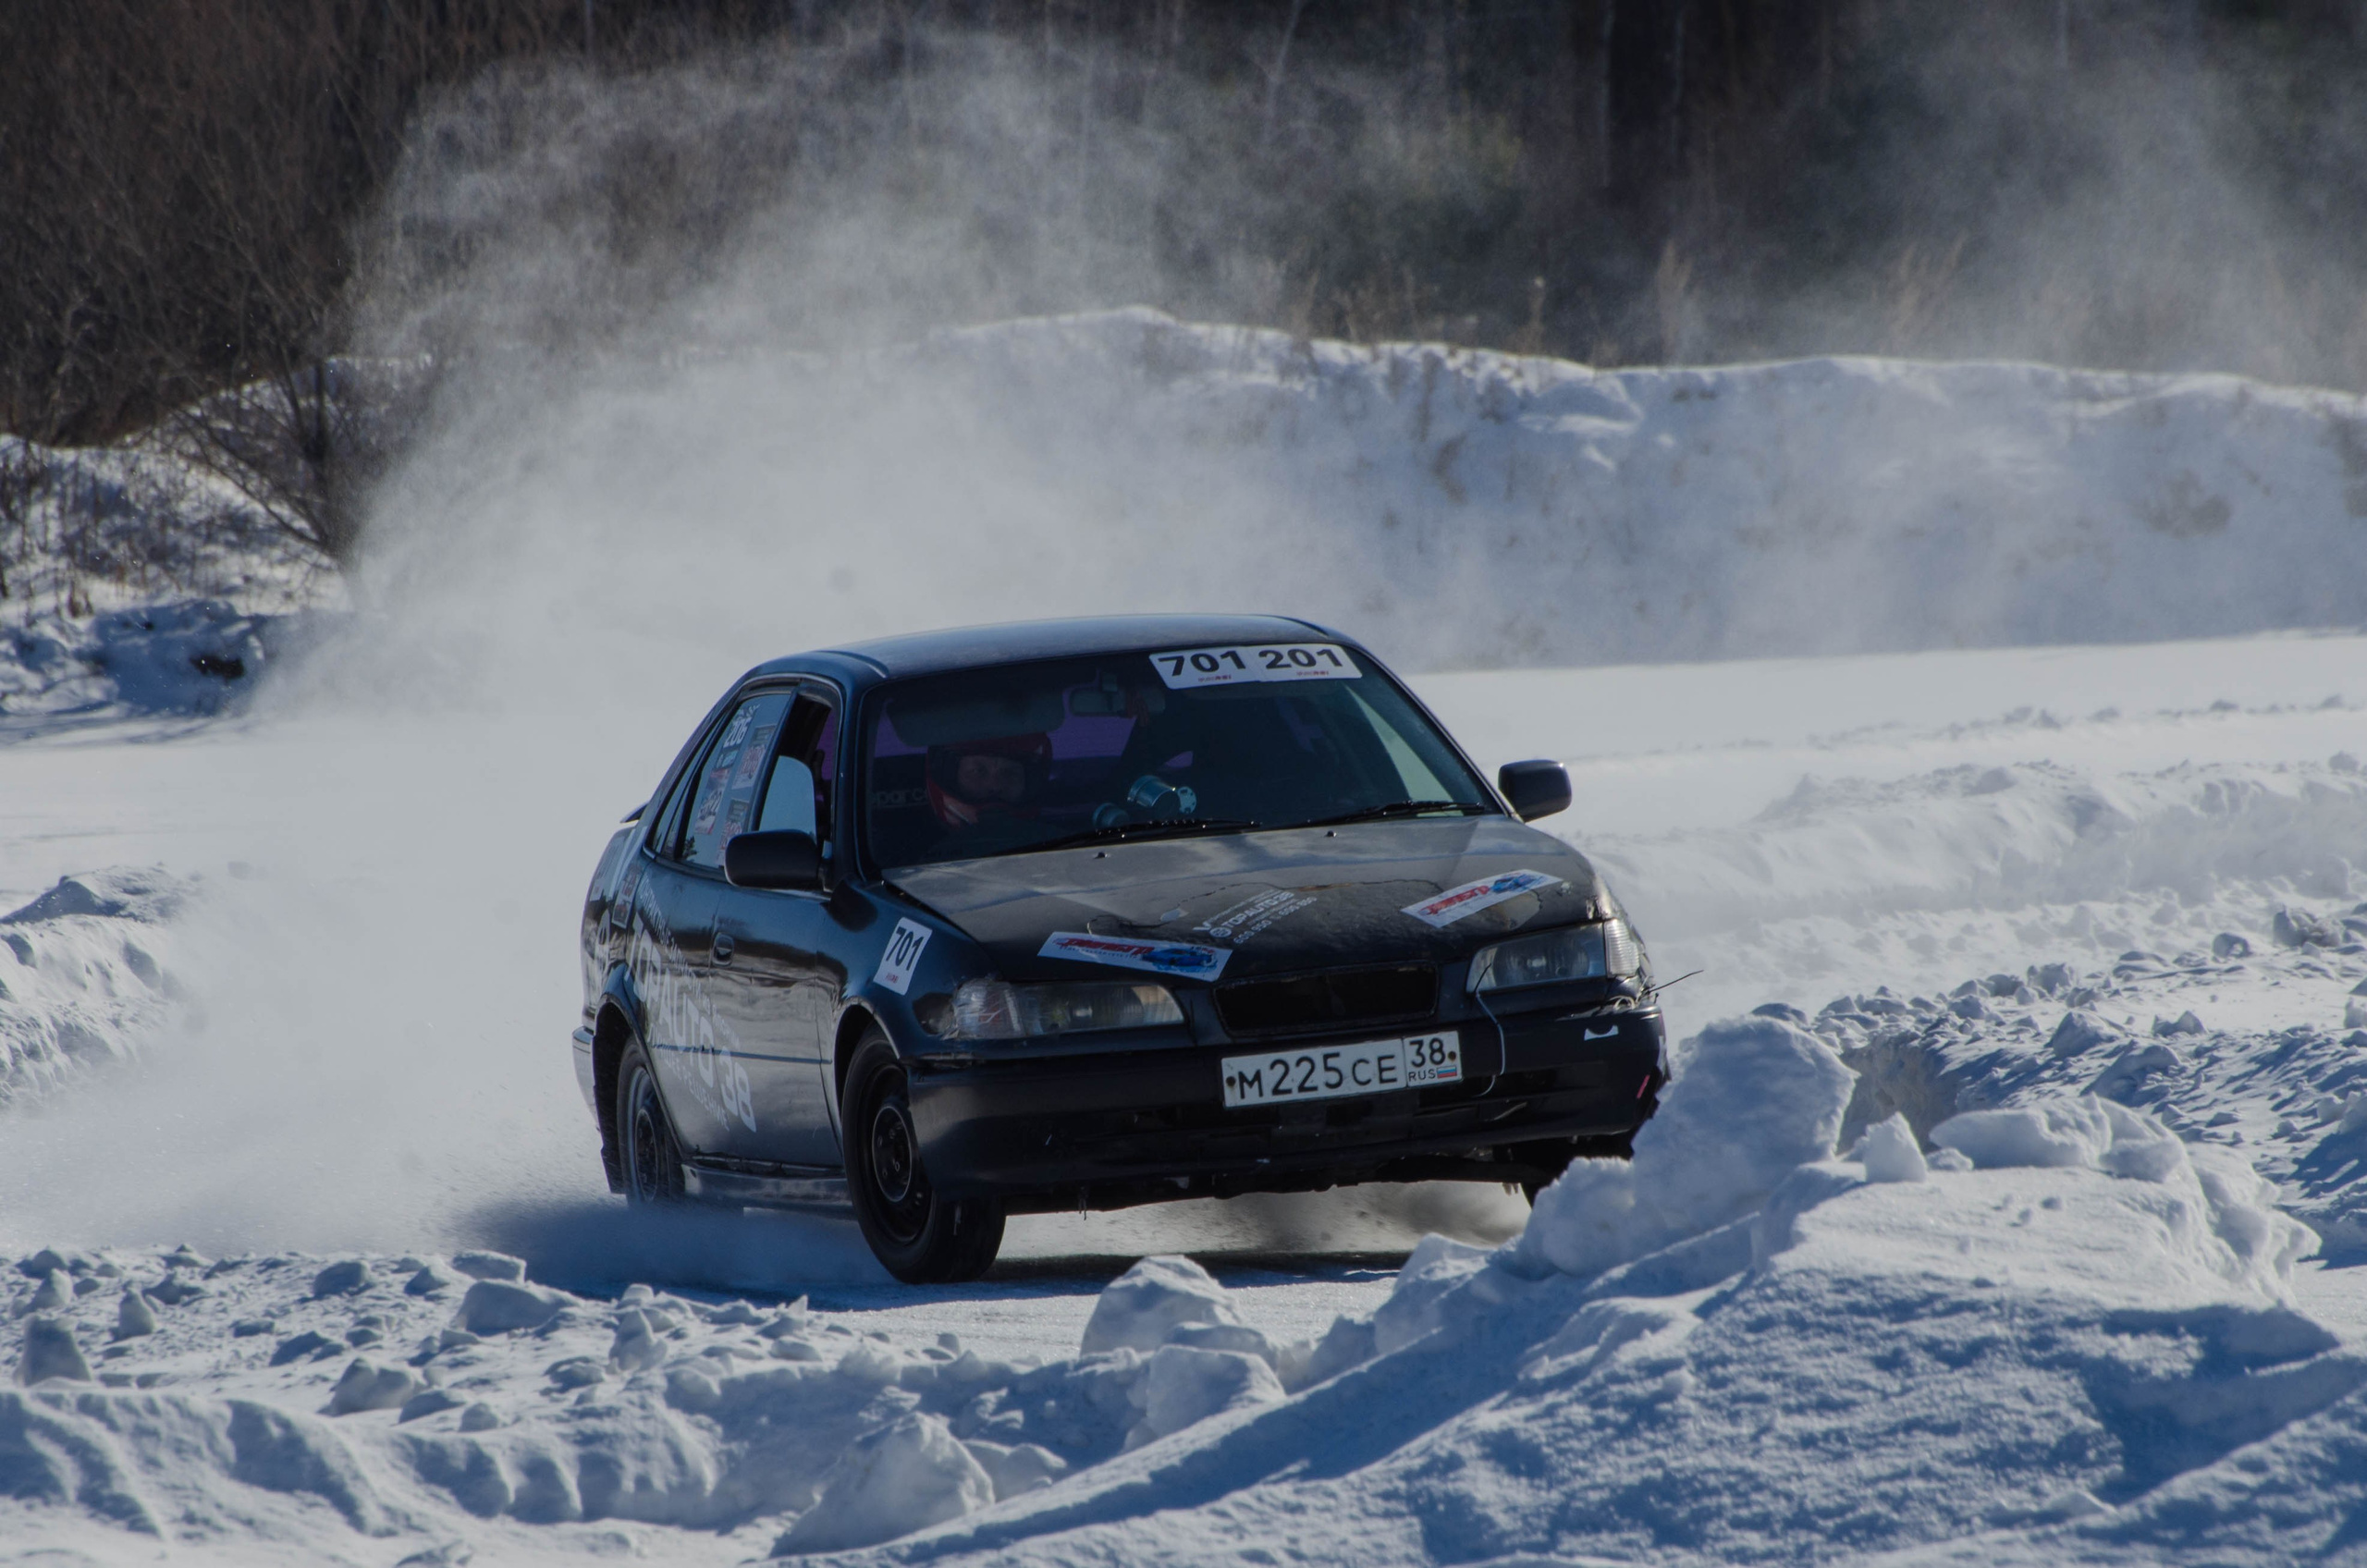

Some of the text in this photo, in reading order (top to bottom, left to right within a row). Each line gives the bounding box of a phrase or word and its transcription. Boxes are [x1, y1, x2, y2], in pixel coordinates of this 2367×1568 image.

[1158, 649, 1343, 677] 701 201
[885, 926, 925, 972] 701
[1237, 1037, 1446, 1100] M225CE 38
[1408, 1069, 1437, 1083] RUS
